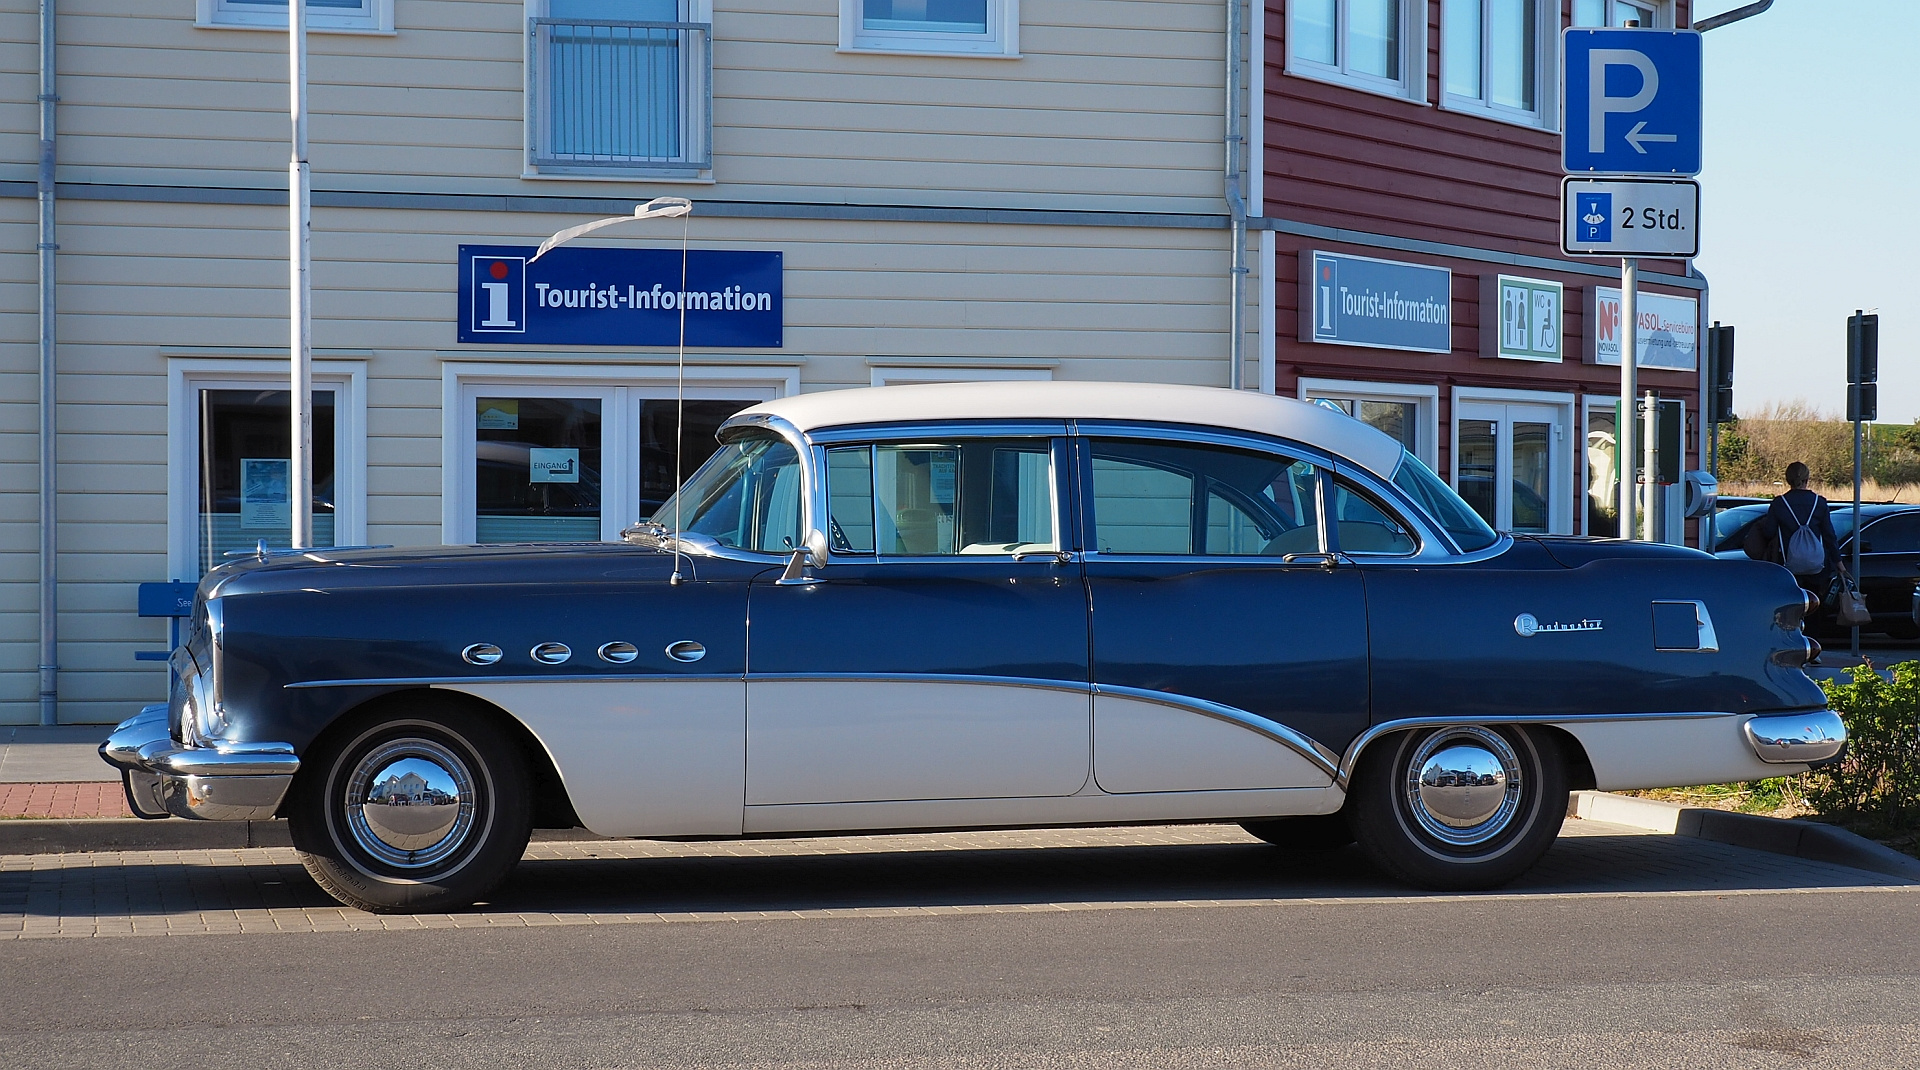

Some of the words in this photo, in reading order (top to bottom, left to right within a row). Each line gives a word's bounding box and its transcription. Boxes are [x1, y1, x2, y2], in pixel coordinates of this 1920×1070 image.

[1588, 48, 1660, 153] P
[1621, 206, 1635, 229] 2
[1641, 207, 1686, 231] Std.
[1589, 226, 1598, 238] P
[534, 281, 772, 311] Tourist-Information
[1340, 286, 1447, 325] Tourist-Information
[1533, 293, 1546, 309] WC
[1621, 310, 1695, 335] ASOL-Servicebüro
[1598, 342, 1619, 353] NOVASOL
[533, 462, 568, 470] EINGANG
[1513, 612, 1604, 637] Roadmaster
